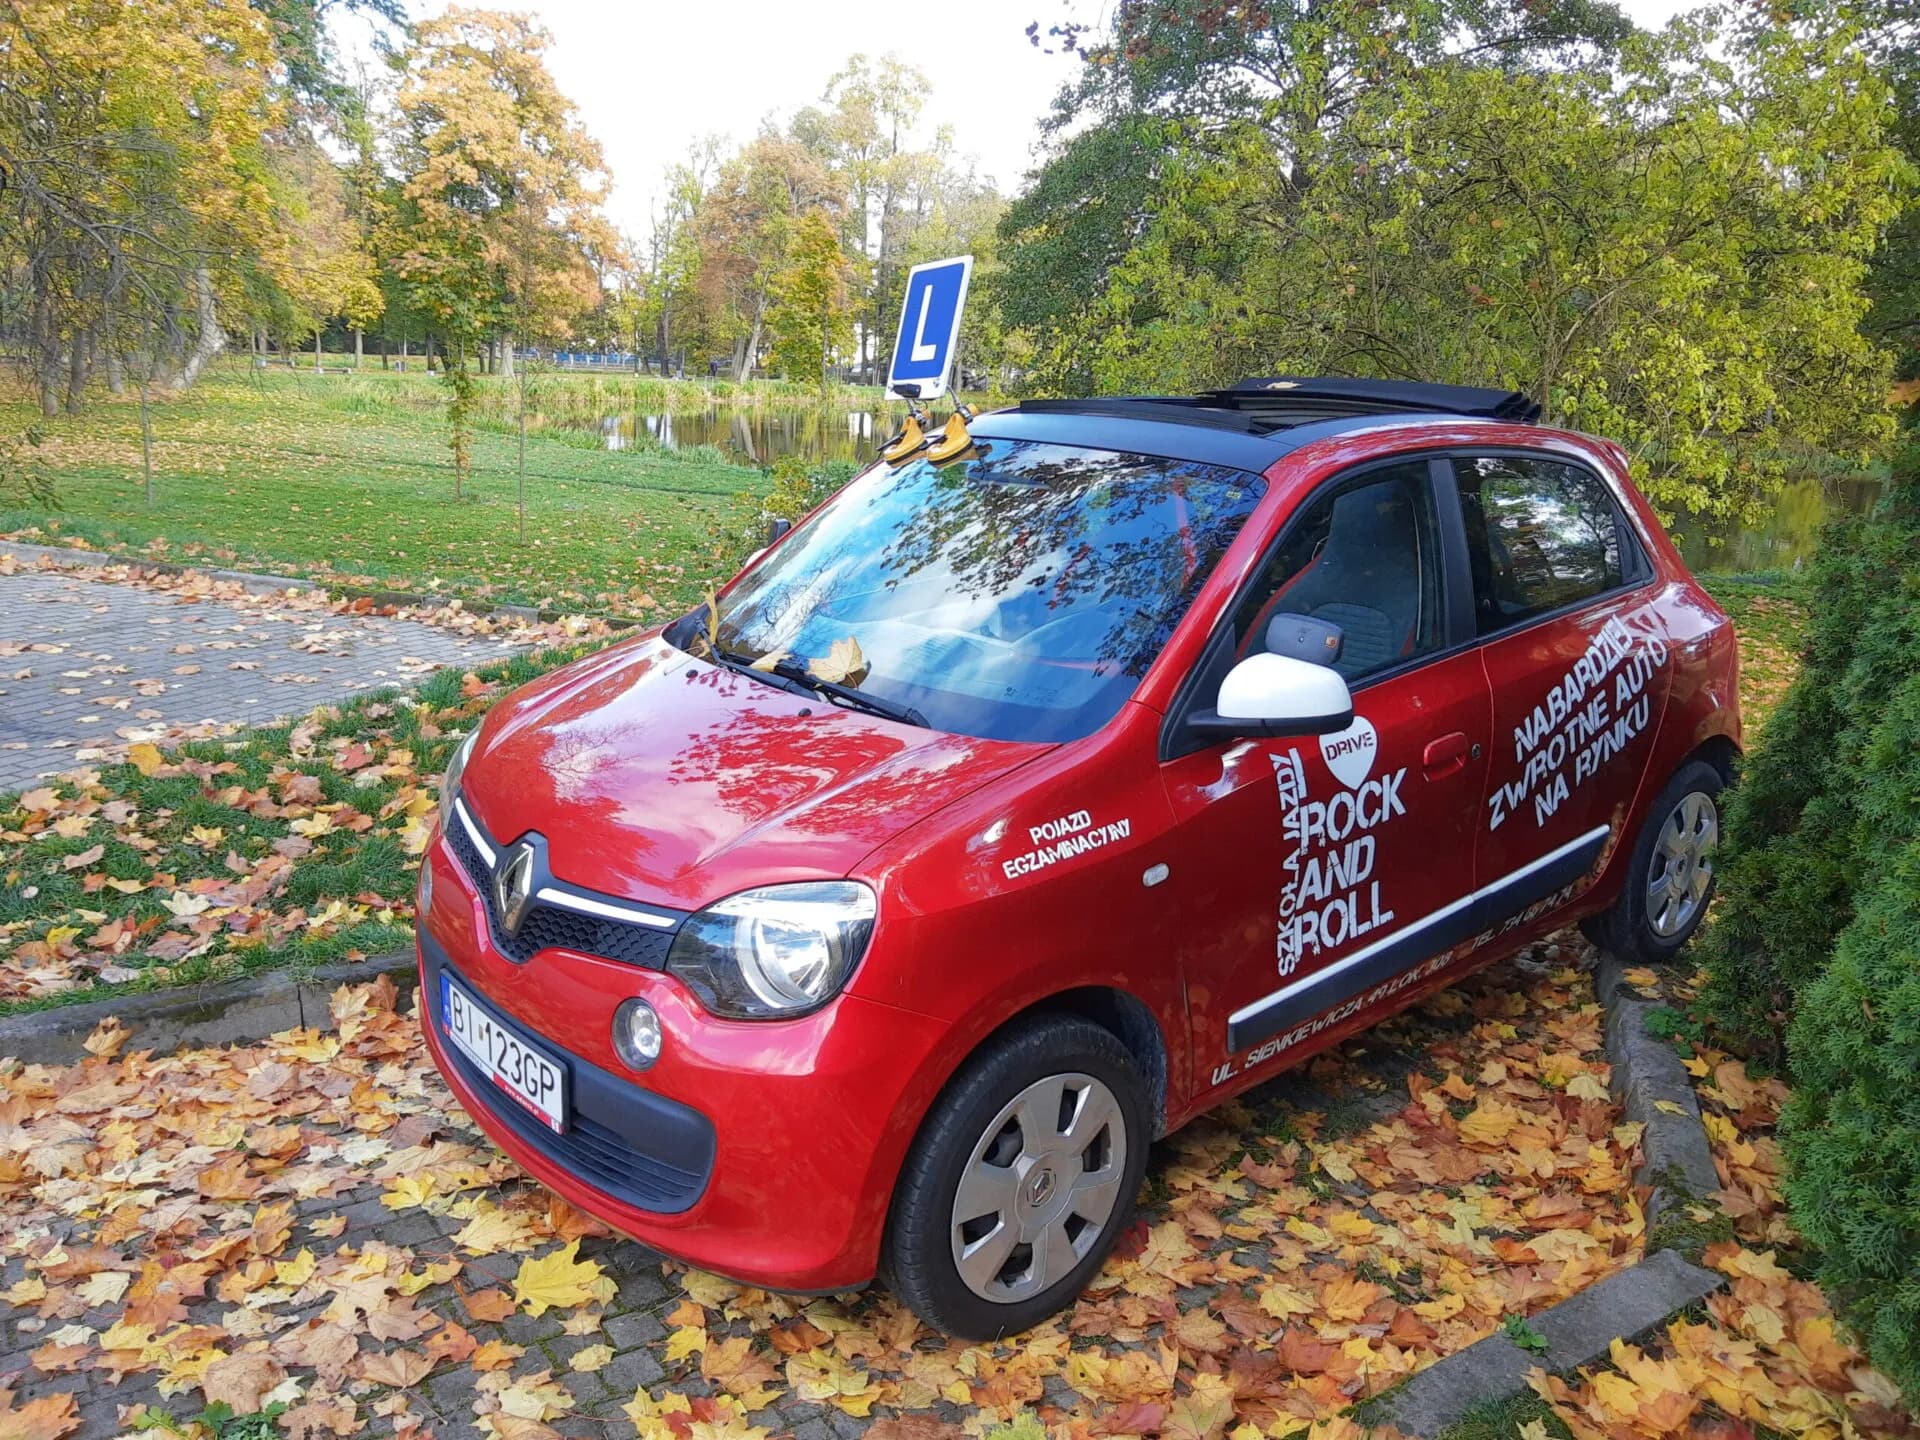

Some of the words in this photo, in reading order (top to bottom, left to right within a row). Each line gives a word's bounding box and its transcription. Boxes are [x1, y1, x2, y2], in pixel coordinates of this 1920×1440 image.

[911, 284, 937, 362] L
[1325, 731, 1375, 761] DRIVE
[1489, 691, 1609, 831] ZWROTNE
[1616, 635, 1668, 711] AUTO
[1535, 773, 1570, 828] NA
[1575, 694, 1649, 786] RYNKU
[1029, 809, 1092, 846] POJAZD
[1268, 752, 1301, 841] JAZDY
[1299, 767, 1408, 856] ROCK
[1277, 847, 1301, 977] SZKOŁA
[1295, 834, 1376, 911] AND
[1293, 879, 1395, 963] ROLL
[452, 990, 473, 1044] BI
[485, 1021, 555, 1105] 123GP
[1211, 1061, 1239, 1086] UL.
